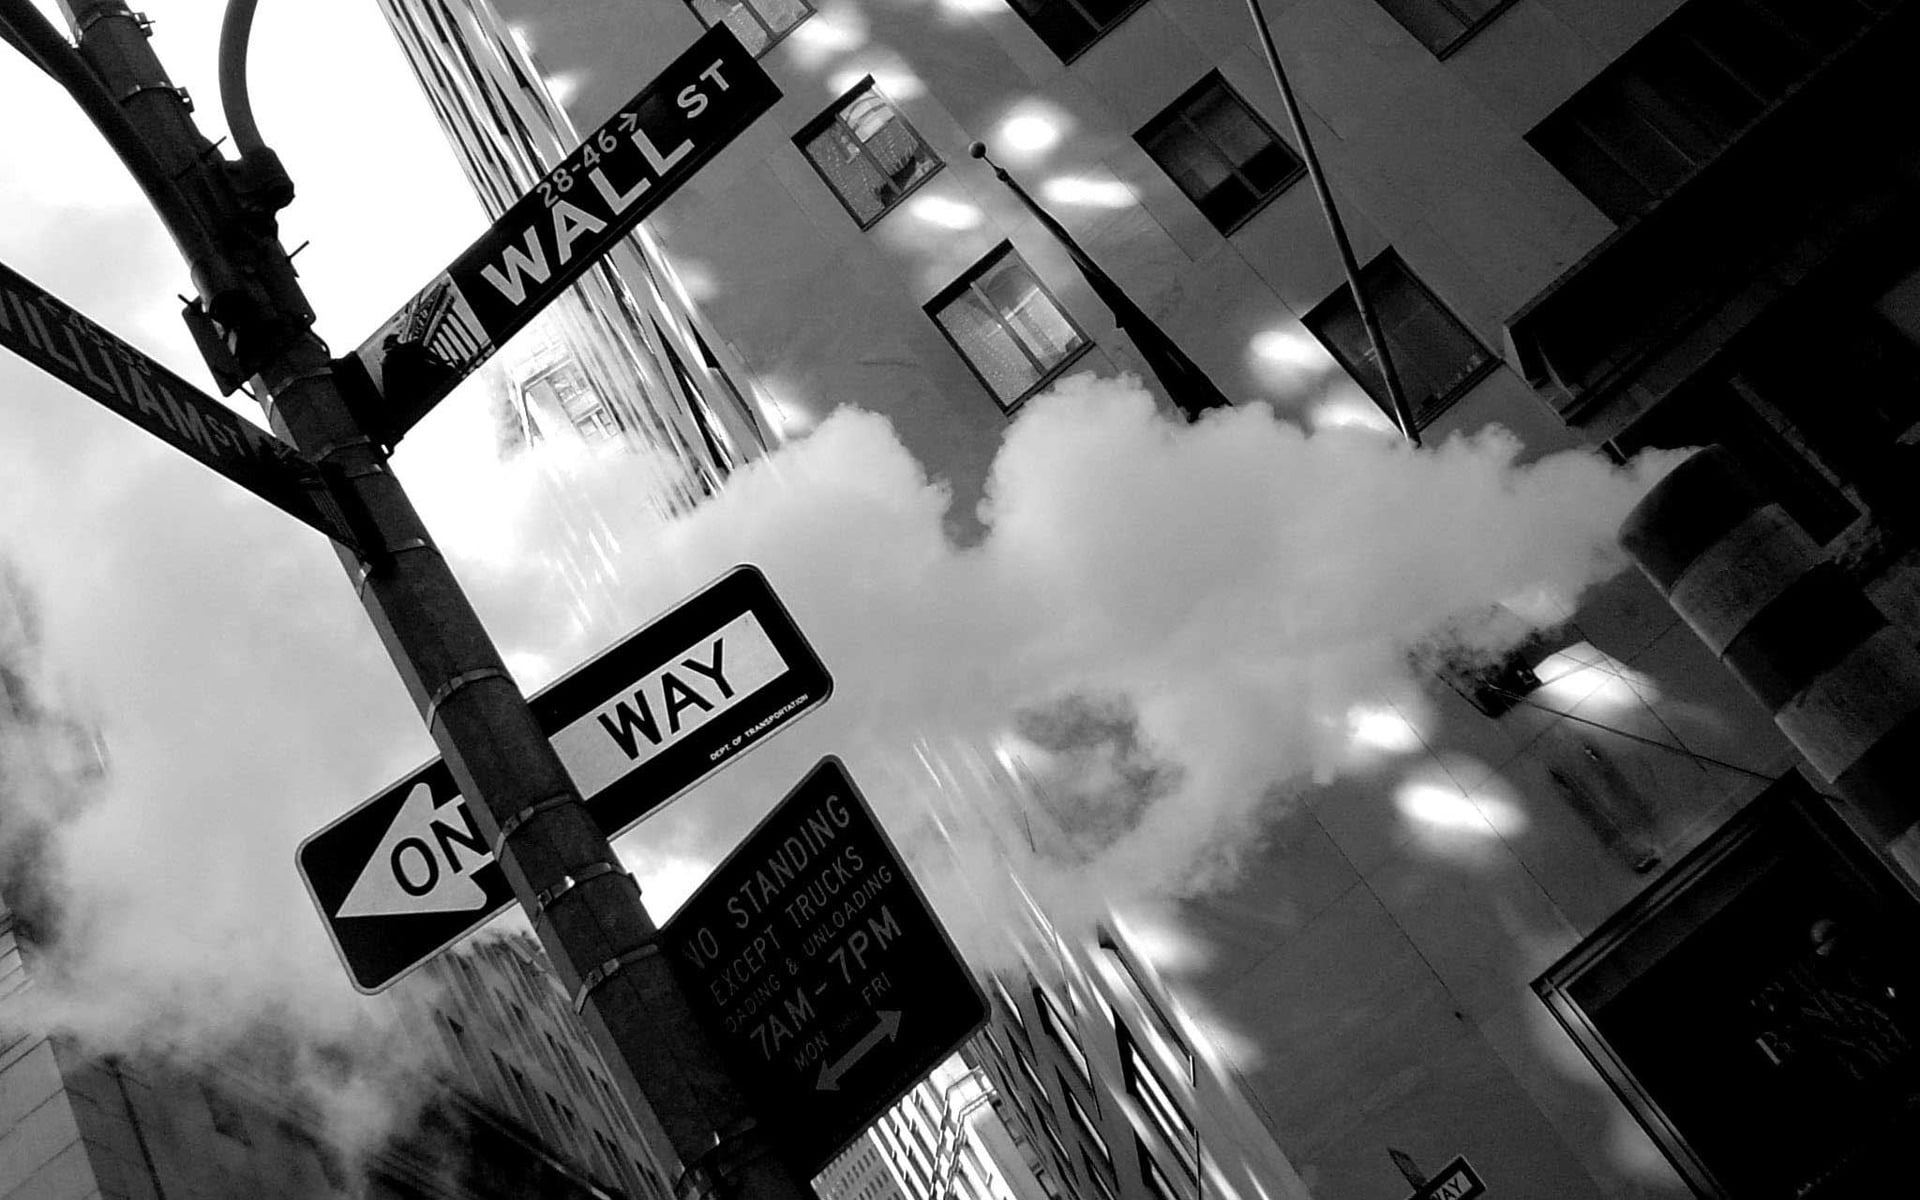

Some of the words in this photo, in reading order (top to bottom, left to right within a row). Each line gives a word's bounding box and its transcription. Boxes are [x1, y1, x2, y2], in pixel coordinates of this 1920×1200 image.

[480, 128, 695, 306] WALL
[676, 58, 730, 119] ST
[536, 129, 617, 208] 28-46
[0, 290, 220, 457] ILLIAM
[205, 413, 246, 458] ST
[597, 638, 735, 761] WAY
[390, 804, 494, 897] ON
[726, 795, 850, 929] STANDING
[710, 924, 781, 1007] EXCEPT
[784, 846, 863, 928] TRUCKS
[725, 974, 781, 1033] OADING
[802, 865, 892, 957] UNLOADING
[793, 1030, 830, 1072] MON
[861, 970, 893, 1007] FRI
